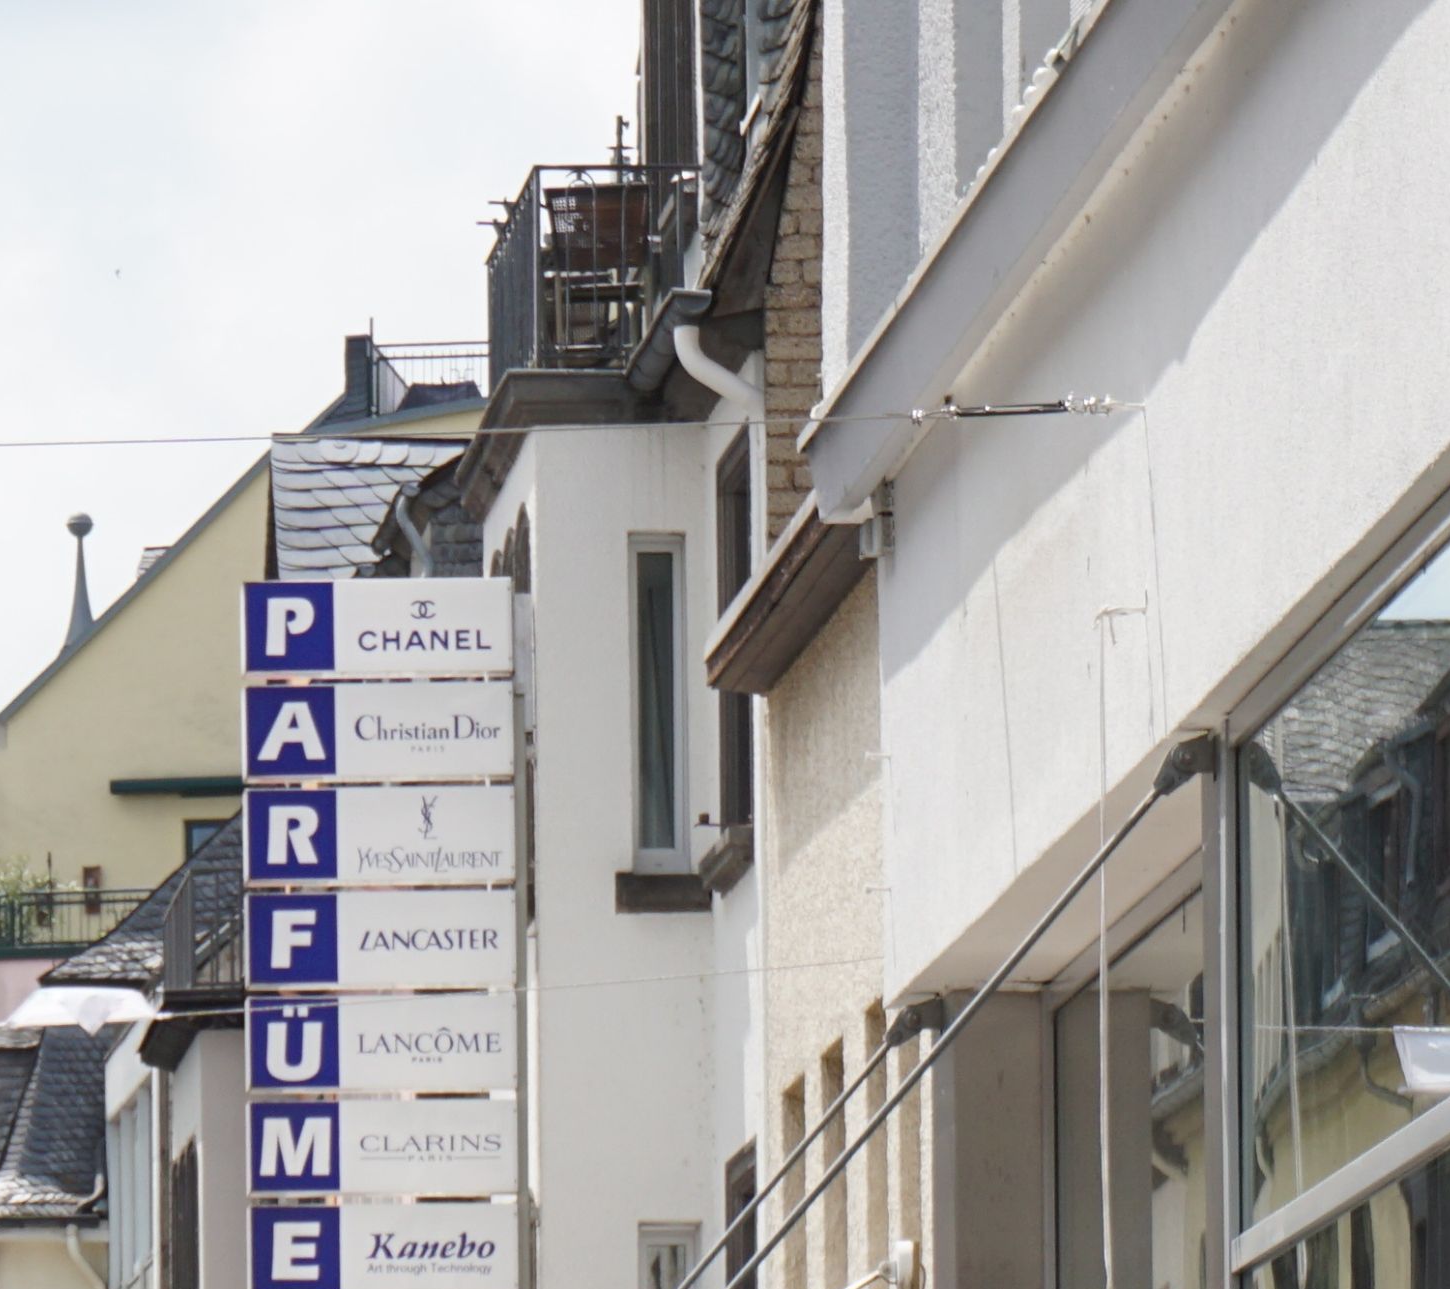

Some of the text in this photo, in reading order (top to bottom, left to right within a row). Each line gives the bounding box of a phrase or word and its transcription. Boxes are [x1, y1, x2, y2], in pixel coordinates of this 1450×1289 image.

[357, 629, 492, 652] CHANEL
[354, 713, 502, 742] Christian Dior
[358, 928, 499, 952] LANCASTER
[356, 1026, 503, 1055] LANCÔME
[359, 1133, 503, 1154] CLARINS
[365, 1232, 496, 1261] Kanebo
[366, 1262, 493, 1277] Art through Technology
